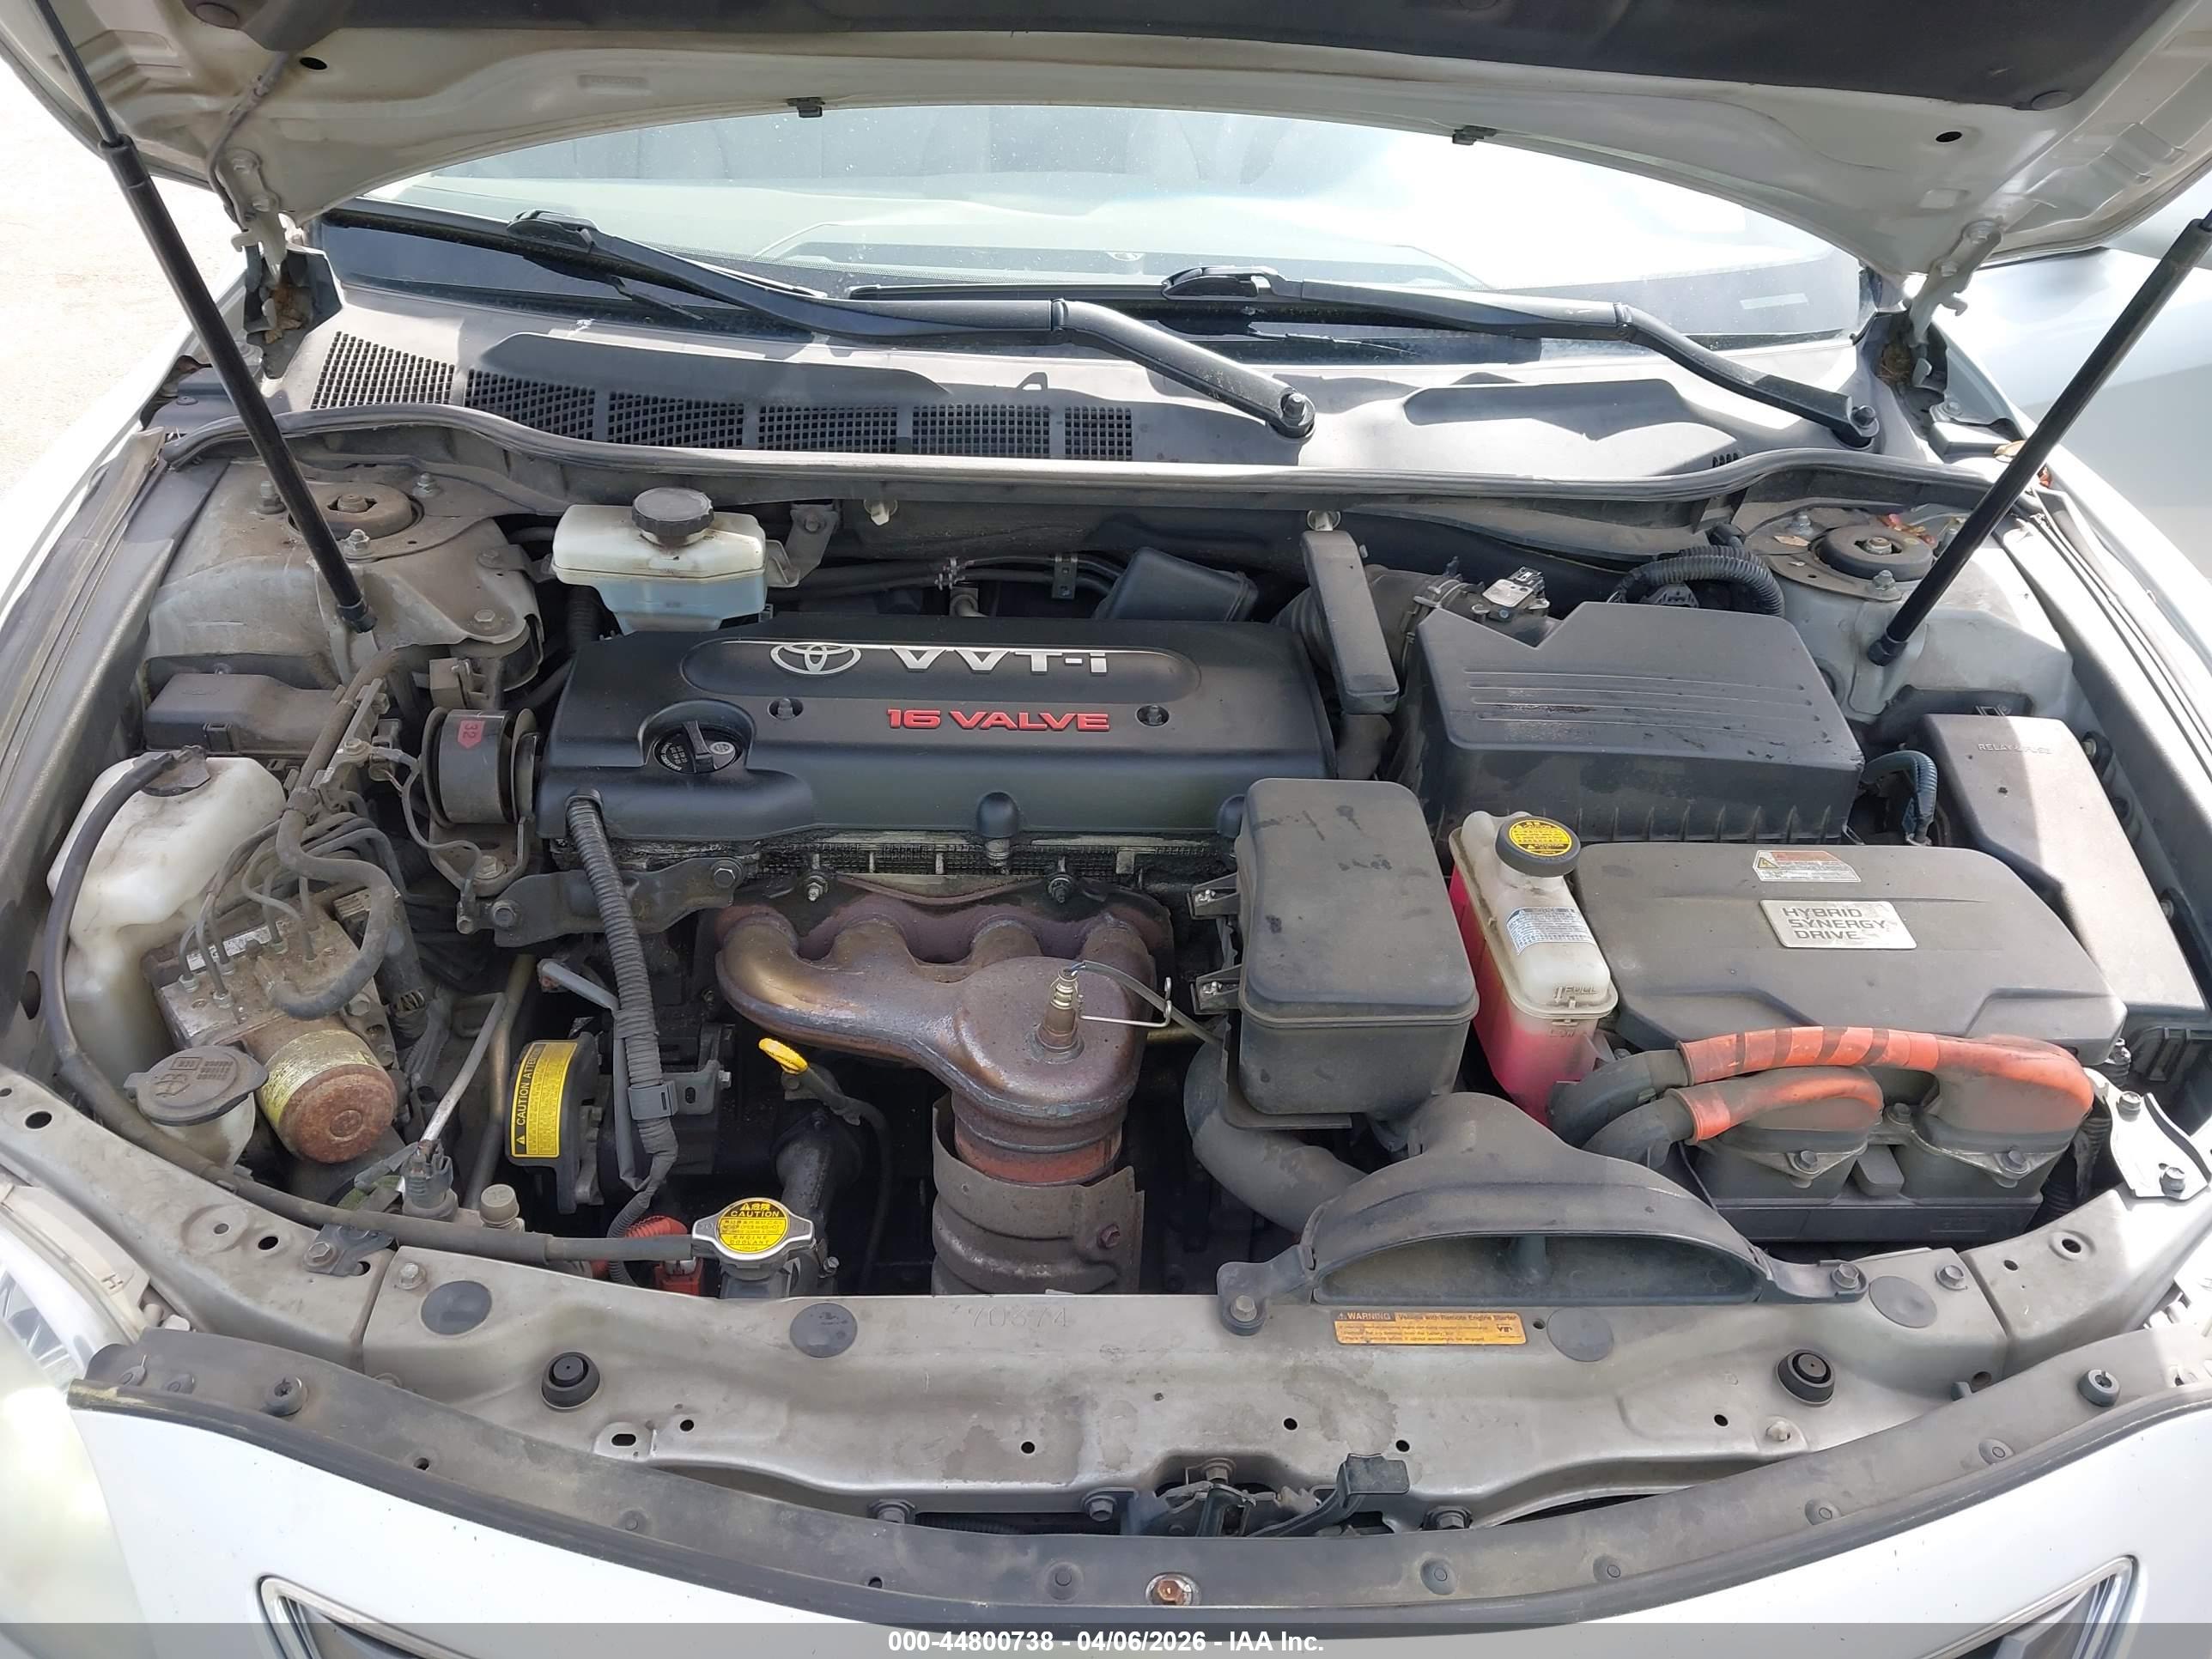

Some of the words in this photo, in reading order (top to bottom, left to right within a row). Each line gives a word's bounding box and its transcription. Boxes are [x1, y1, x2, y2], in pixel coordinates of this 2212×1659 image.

[890, 647, 1107, 674] VVT-i
[887, 708, 942, 730] 16
[949, 710, 1111, 732] VALVE
[1782, 907, 1863, 918] HYBRID
[1788, 919, 1886, 929] SYNERGY
[1794, 930, 1861, 940] DRIVE
[1565, 985, 1598, 995] FULL
[516, 1082, 530, 1126] CAUTION
